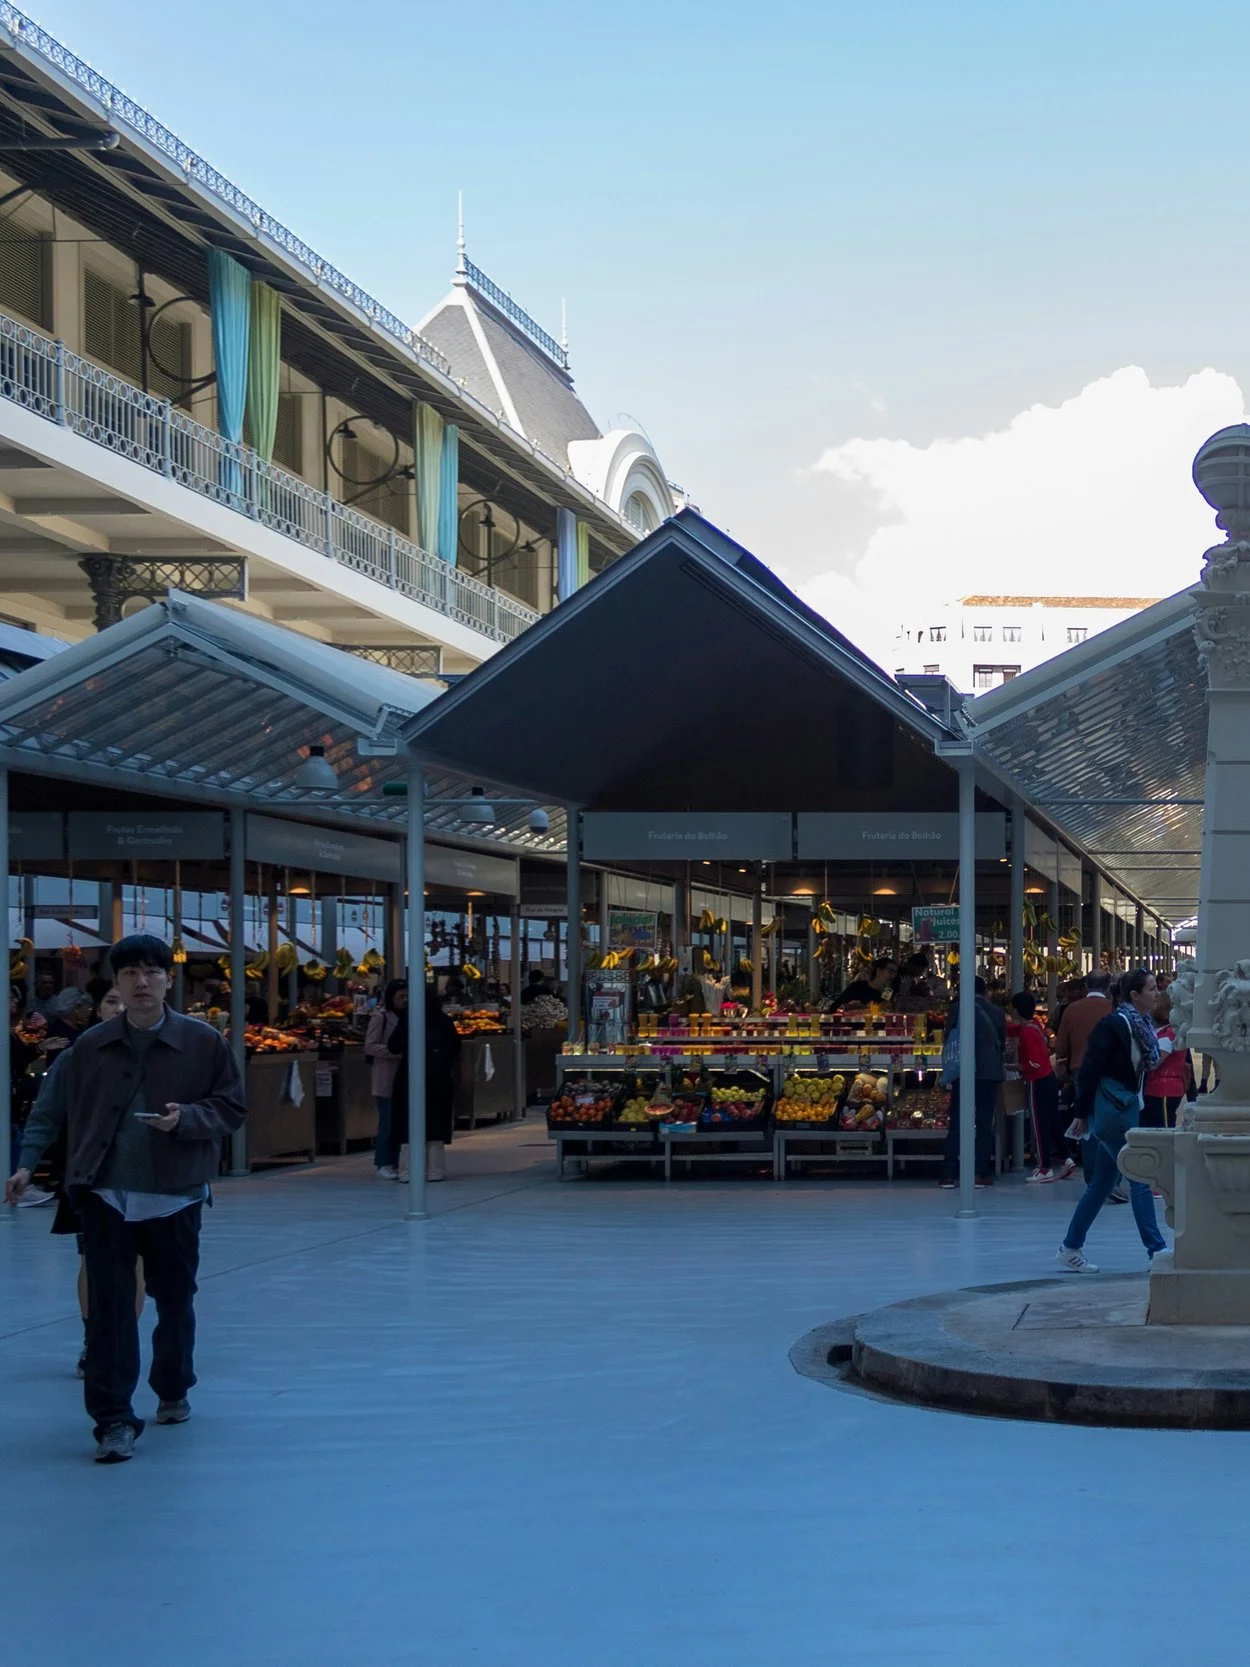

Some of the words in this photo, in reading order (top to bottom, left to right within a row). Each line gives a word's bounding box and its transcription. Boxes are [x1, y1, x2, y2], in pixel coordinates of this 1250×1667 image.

[107, 825, 134, 834] Frutas
[648, 831, 683, 840] Frutaria
[684, 831, 696, 840] do
[697, 831, 728, 840] Bolhão
[862, 831, 897, 840] Frutaria
[898, 831, 910, 840] do
[911, 831, 942, 840] Bolhão
[915, 908, 954, 917] Natural
[932, 917, 960, 927] Juices
